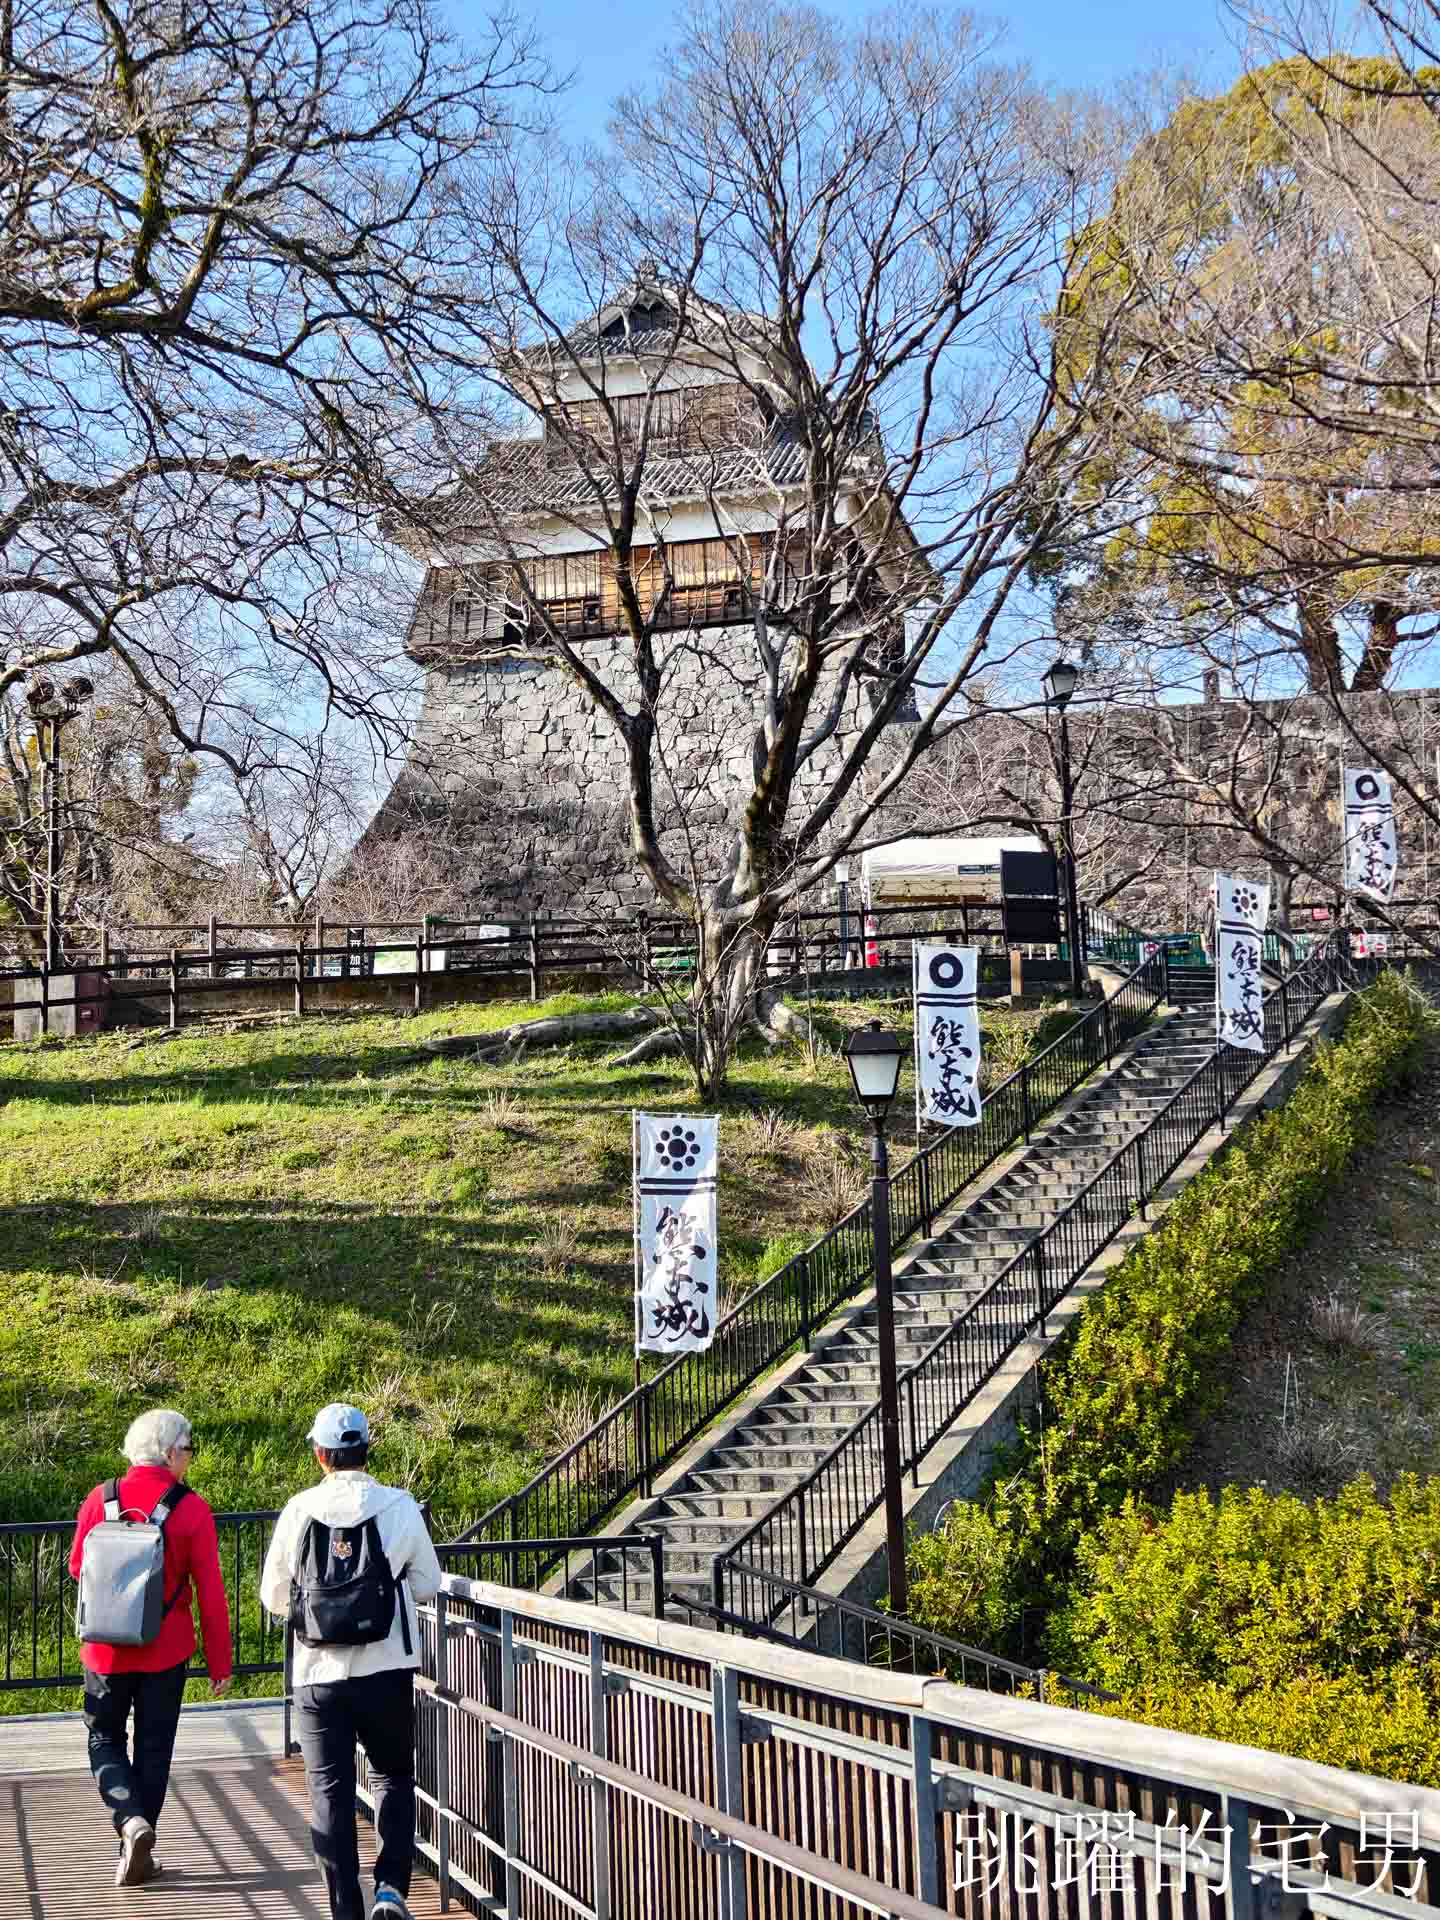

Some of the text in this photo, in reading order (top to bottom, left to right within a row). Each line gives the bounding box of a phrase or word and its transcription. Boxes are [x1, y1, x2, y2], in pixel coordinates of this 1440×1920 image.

[1226, 939, 1264, 1040] 熊本城
[928, 1015, 977, 1118] 熊本城
[648, 1206, 709, 1343] 熊本城
